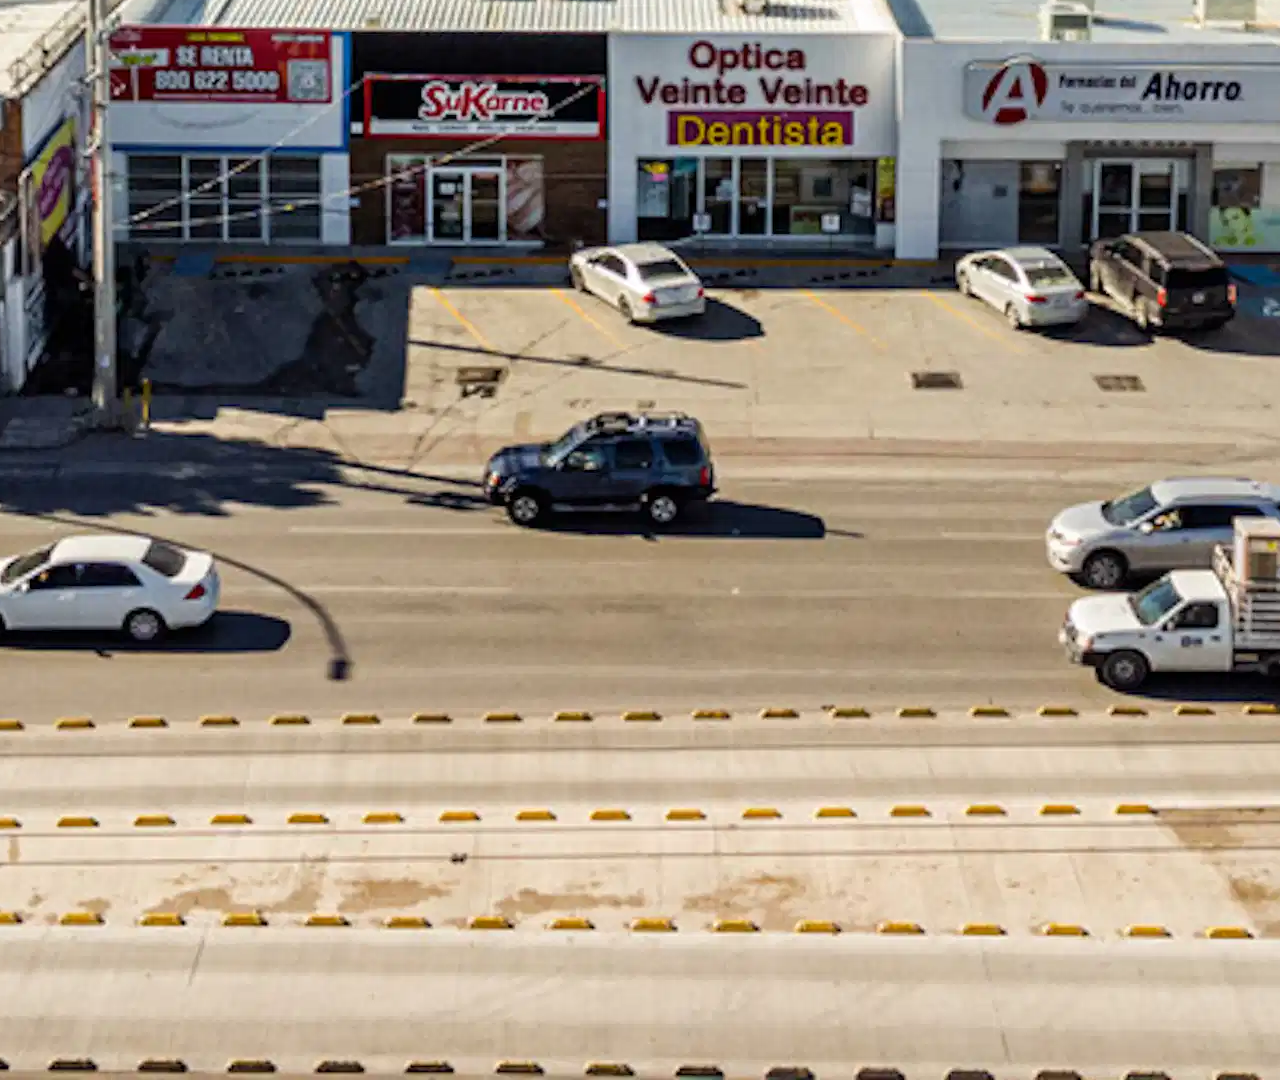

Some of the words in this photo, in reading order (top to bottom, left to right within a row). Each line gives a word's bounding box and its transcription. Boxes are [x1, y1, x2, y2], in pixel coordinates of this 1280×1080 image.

[176, 45, 197, 66] SE
[200, 46, 254, 66] RENTA
[689, 40, 806, 74] Optica
[419, 80, 548, 122] SuKarne
[636, 76, 747, 105] Veinte
[759, 77, 869, 106] Veinte
[1059, 74, 1116, 88] Farmacias
[1142, 72, 1242, 101] Ahorro
[676, 115, 845, 148] Dentista
